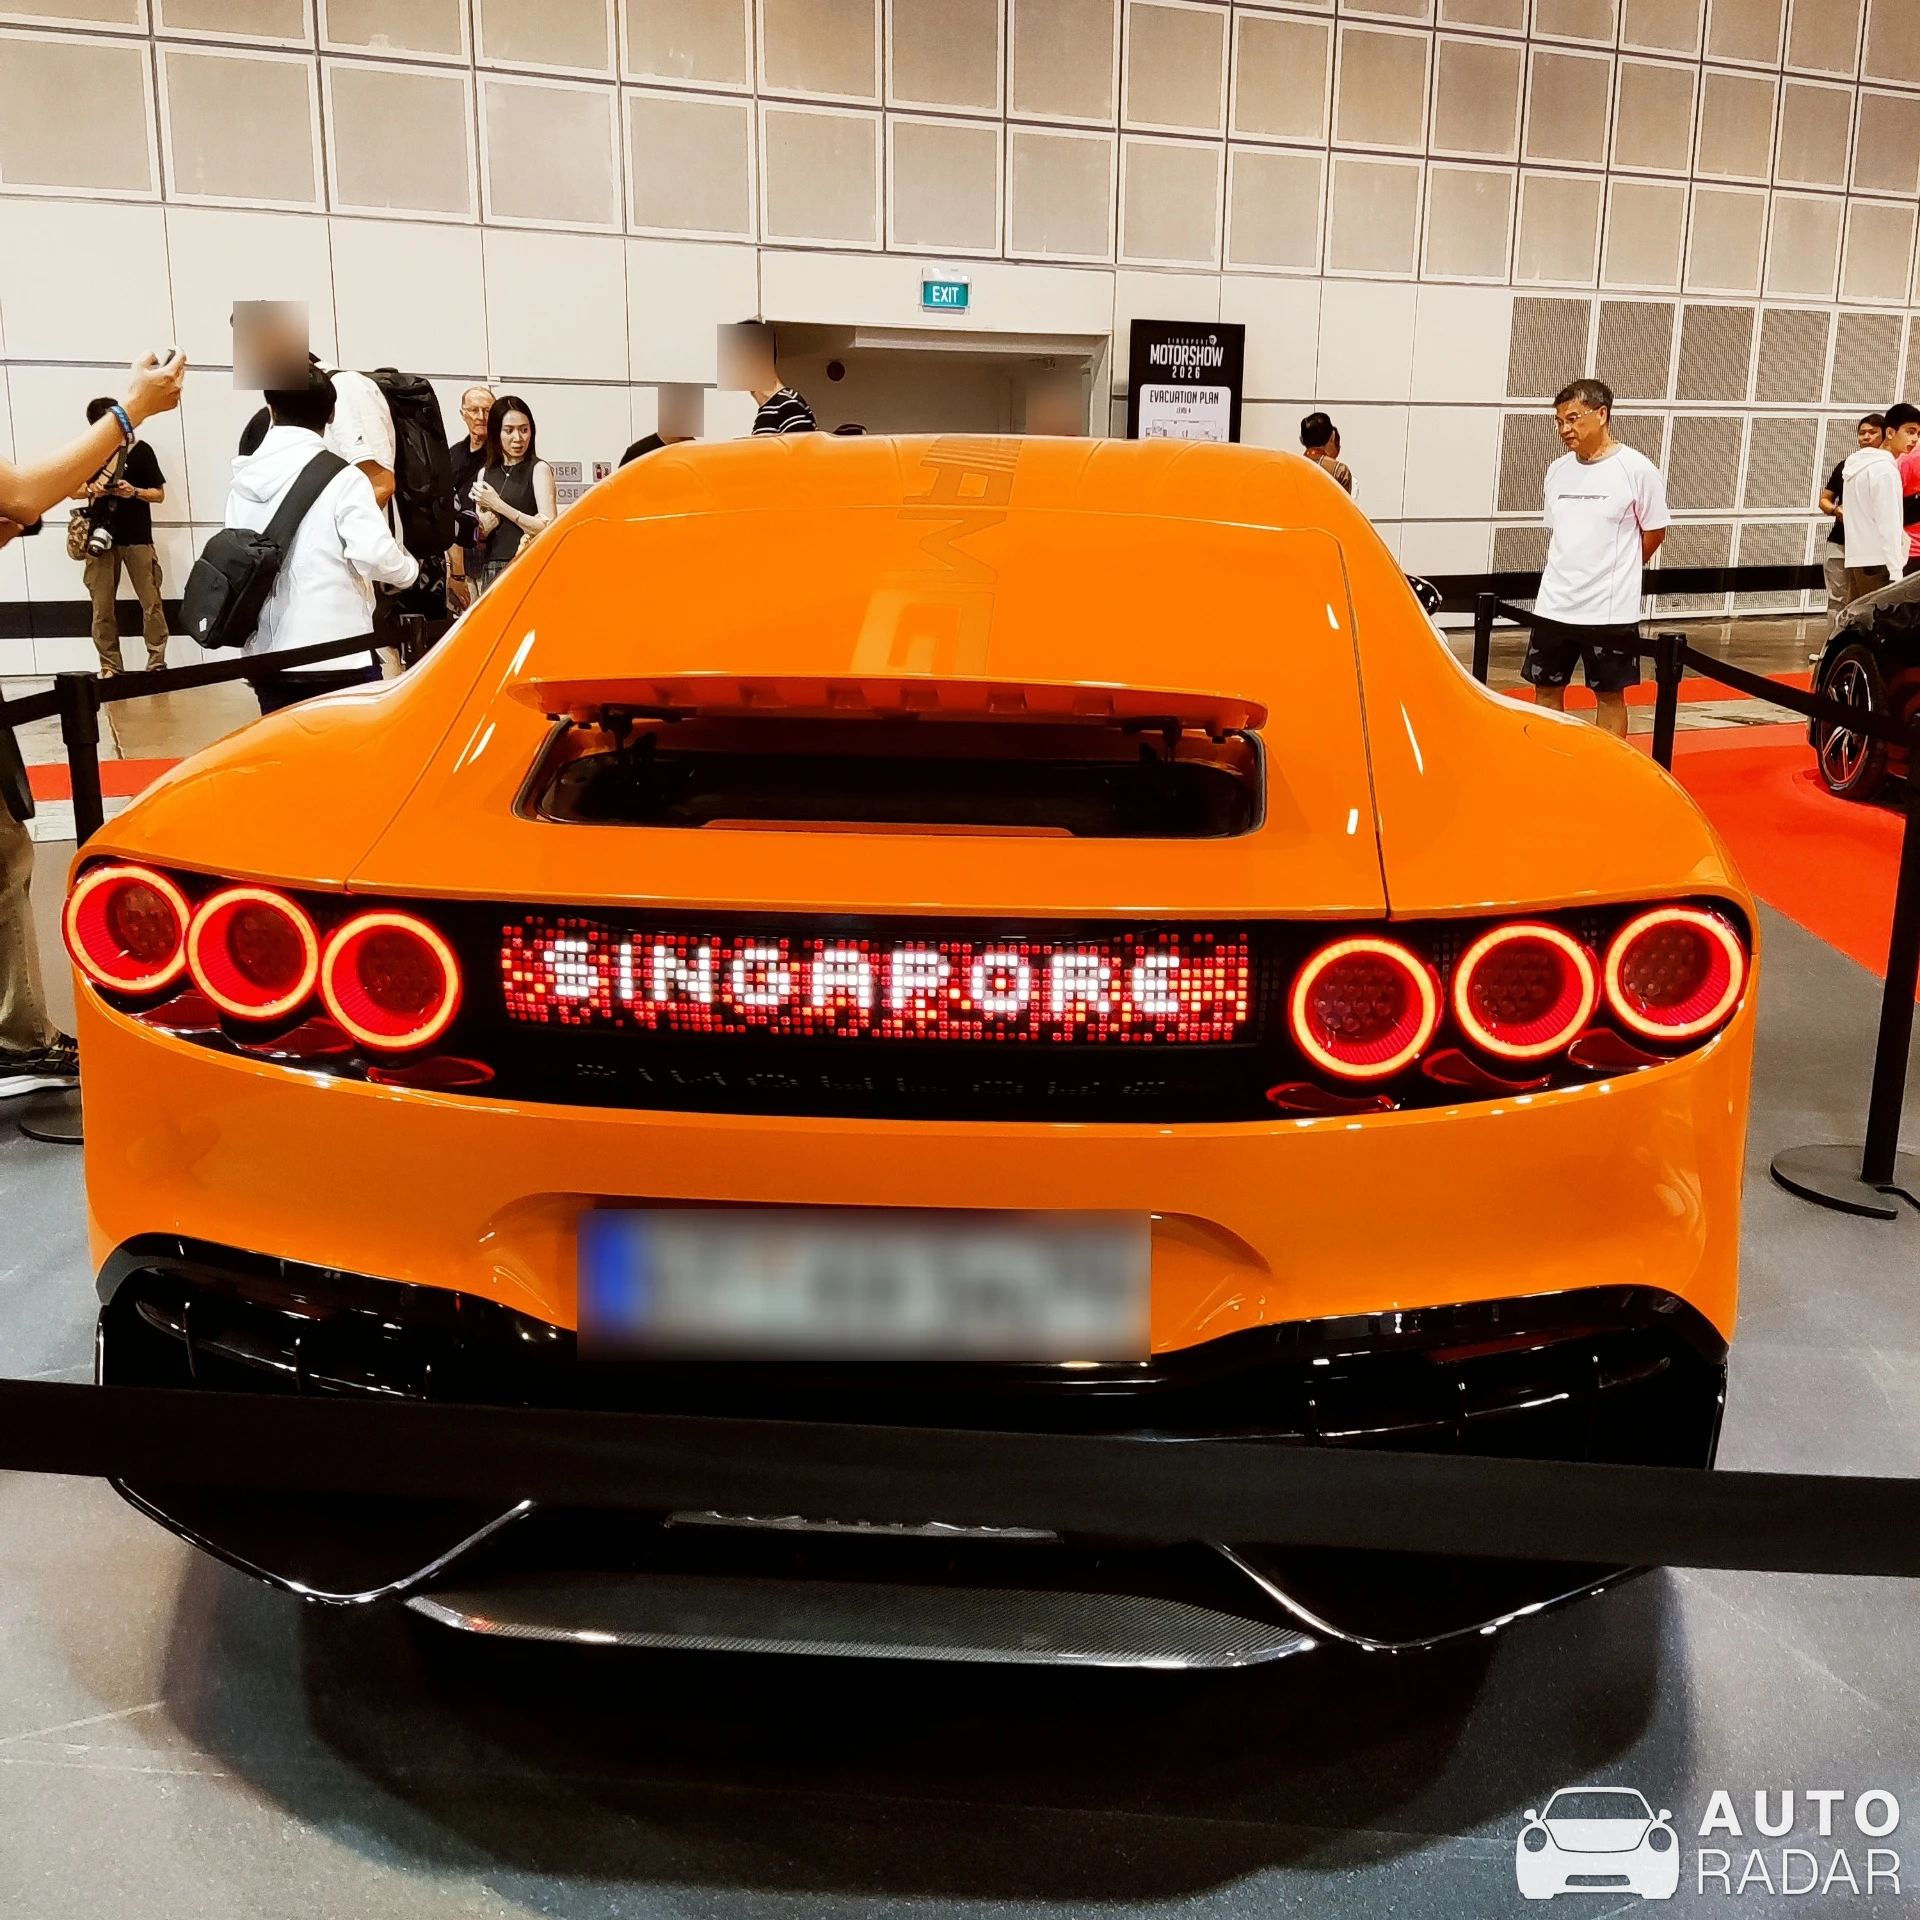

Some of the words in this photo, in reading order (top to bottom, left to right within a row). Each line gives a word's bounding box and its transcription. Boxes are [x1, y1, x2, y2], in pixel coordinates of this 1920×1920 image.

[932, 285, 960, 303] EXIT
[1149, 343, 1224, 367] MOTORSHOW
[1171, 365, 1201, 379] 2026
[1149, 389, 1198, 404] EVACUATION
[1199, 391, 1220, 405] PLAN
[558, 488, 579, 498] OSE
[850, 459, 1015, 676] AMG
[543, 940, 1181, 1013] SINGAPORE
